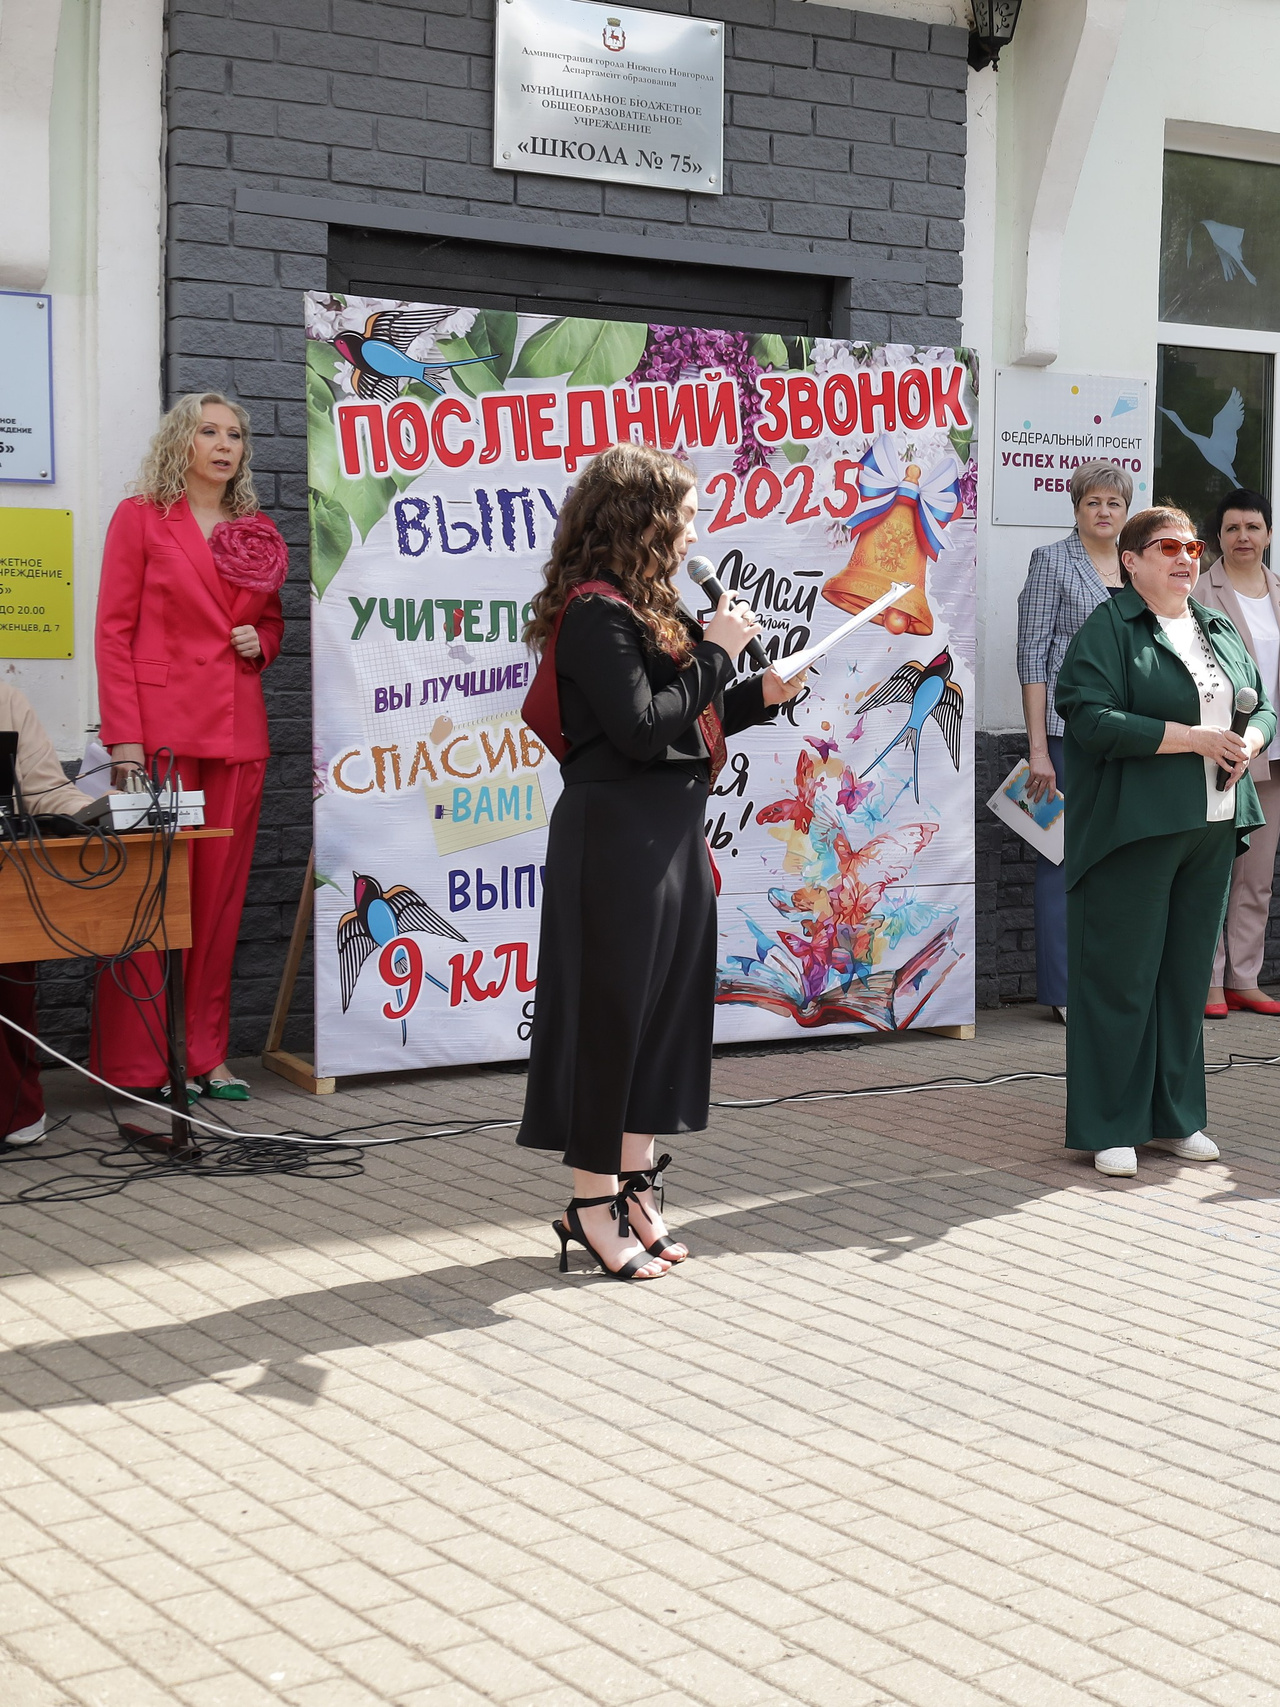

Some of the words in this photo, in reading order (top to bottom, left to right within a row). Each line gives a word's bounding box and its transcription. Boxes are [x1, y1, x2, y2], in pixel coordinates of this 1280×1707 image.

[521, 46, 594, 64] Администрация
[595, 58, 625, 71] города
[626, 61, 667, 75] Нижнего
[669, 67, 715, 83] Новгорода
[562, 64, 622, 80] Департамент
[622, 73, 677, 88] образования
[520, 83, 627, 106] МУНИЦИПАЛЬНОЕ
[629, 98, 702, 116] БЮДЖЕТНОЕ
[541, 99, 683, 126] ОБЩЕОБРАЗОВАТЕЛЬНОЕ
[574, 116, 652, 134] УЧРЕЖДЕНИЕ
[517, 136, 629, 166] «ШКОЛА
[635, 150, 664, 169] №
[670, 153, 703, 174] 75»
[338, 372, 738, 475] ПОСЛЕДНИЙ
[757, 366, 968, 442] ЗВОНОК
[1001, 431, 1093, 447] ФЕДЕРАЛЬНЫЙ
[1096, 435, 1142, 450] ПРОЕКТ
[1001, 452, 1055, 469] УСПЕХ
[1059, 455, 1142, 473] КАОГО
[705, 459, 865, 533] 2025
[17, 605, 45, 615] 20.00
[43, 624, 52, 633] Д.
[54, 624, 60, 632] 7
[374, 682, 412, 714] ВЫ
[419, 661, 530, 706] ЛУЧШИЕ!
[451, 785, 534, 825] ВАМ!
[449, 864, 546, 913] ВЫП
[378, 937, 423, 1020] 9
